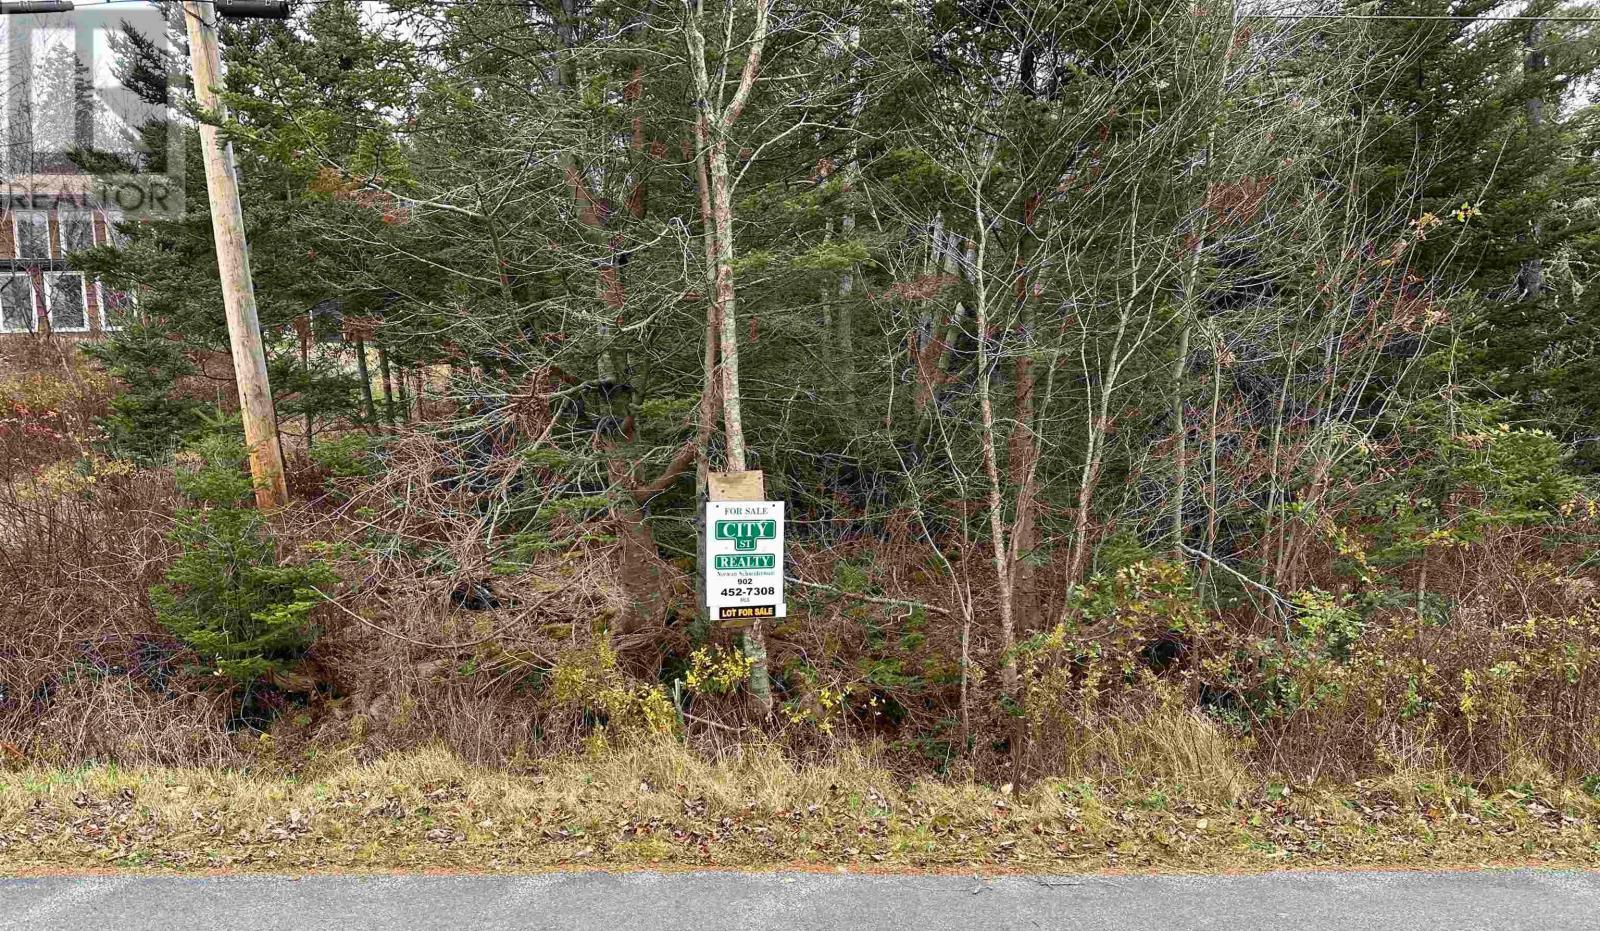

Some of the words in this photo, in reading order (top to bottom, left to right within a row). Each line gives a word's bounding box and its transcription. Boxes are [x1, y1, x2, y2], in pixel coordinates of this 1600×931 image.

[724, 507, 742, 515] FOR
[745, 507, 768, 515] SALE
[723, 522, 769, 537] CITY
[739, 540, 751, 548] ST
[720, 555, 770, 567] REALTY
[720, 587, 775, 596] 452-7308
[722, 609, 737, 617] LOT
[738, 608, 753, 616] FOR
[754, 607, 773, 615] SALE
